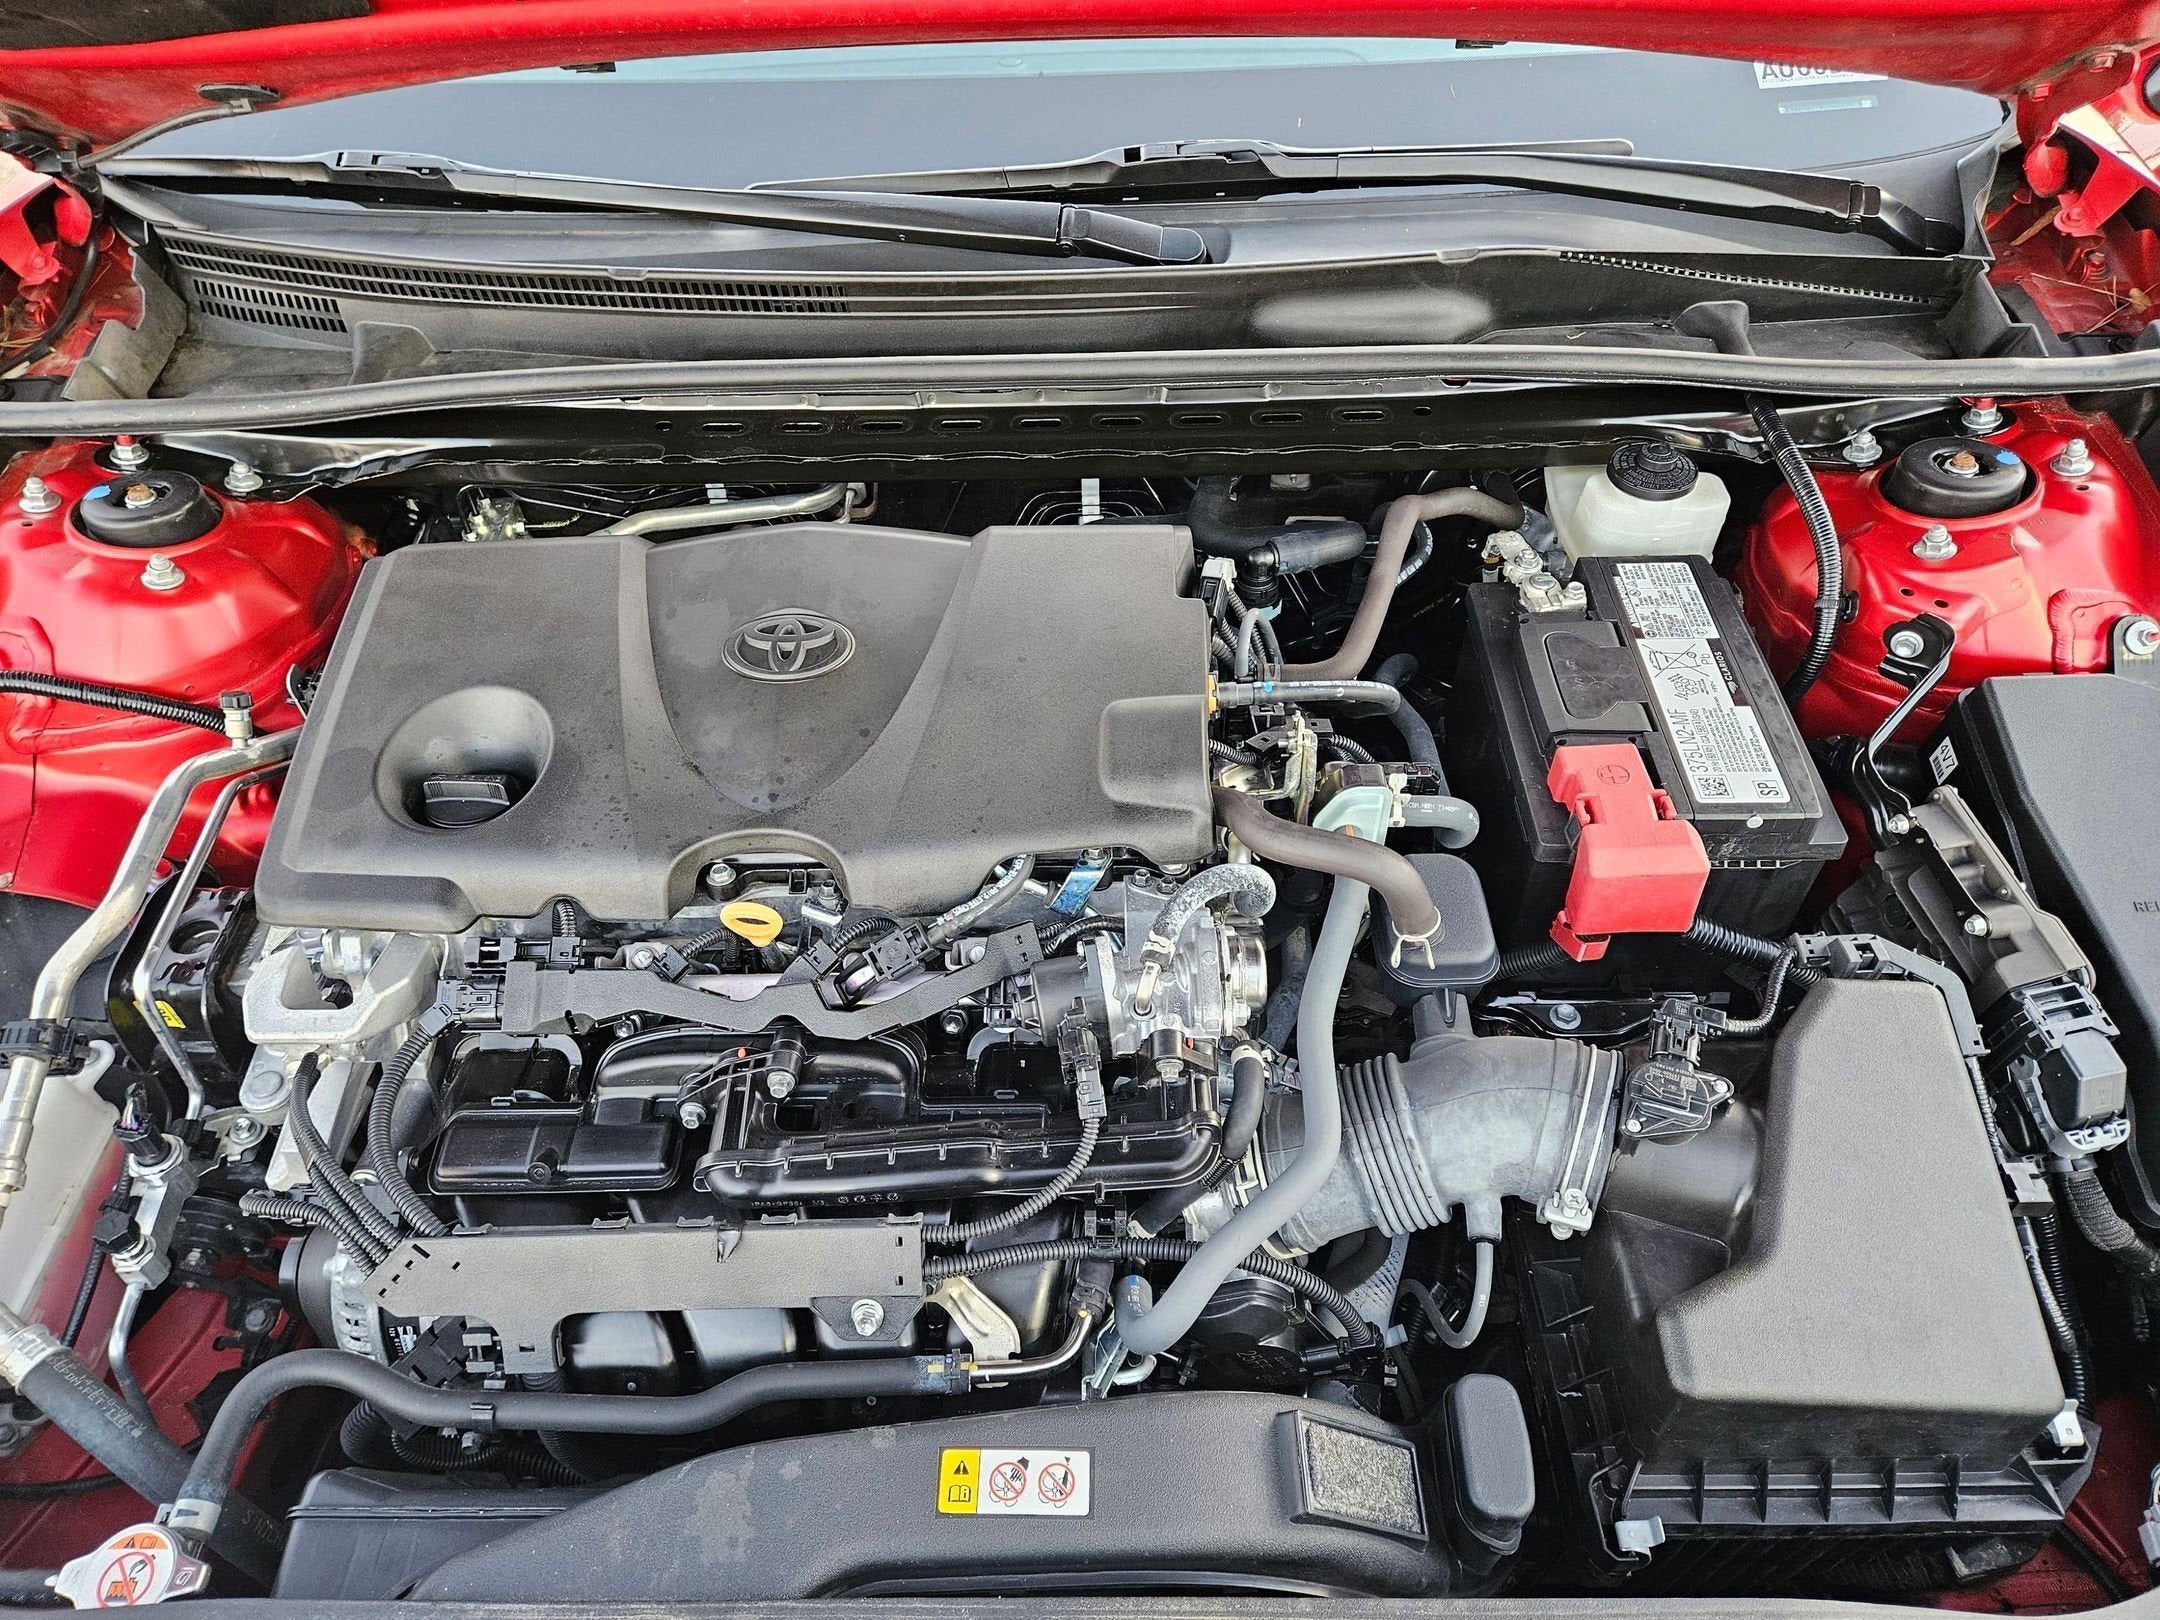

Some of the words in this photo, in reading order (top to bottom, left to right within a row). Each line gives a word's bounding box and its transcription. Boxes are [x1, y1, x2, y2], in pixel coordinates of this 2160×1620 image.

[1700, 653, 1713, 665] Pb
[1714, 651, 1733, 681] CLARIOS
[1667, 708, 1709, 773] 375LN2-MF
[1940, 744, 1956, 769] 4V7
[1757, 782, 1780, 796] SP
